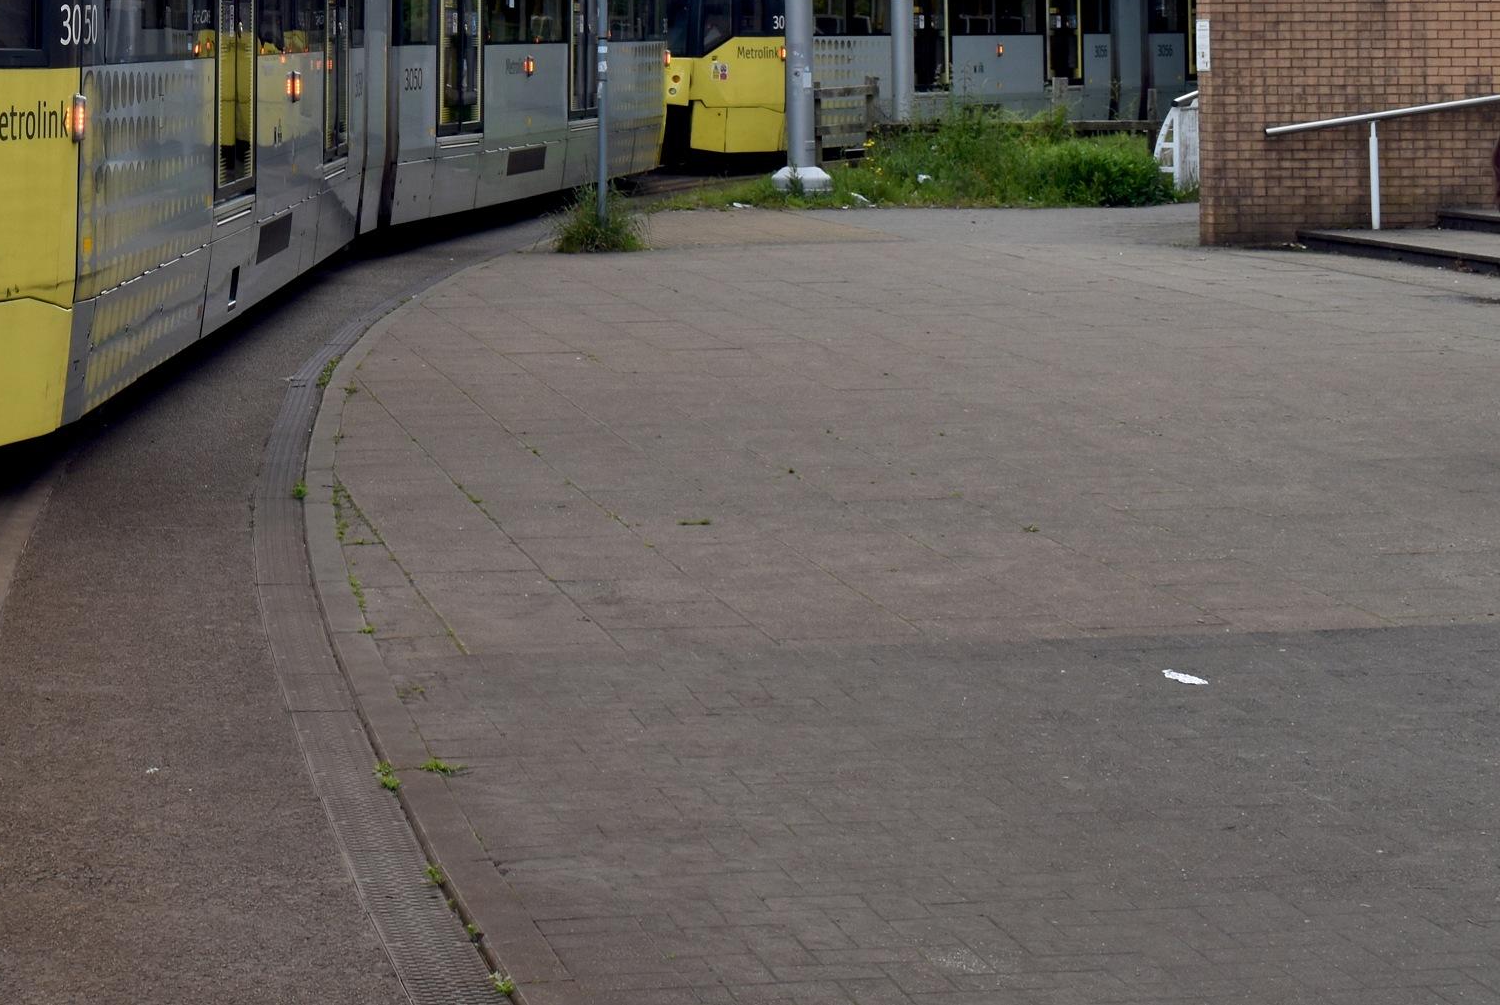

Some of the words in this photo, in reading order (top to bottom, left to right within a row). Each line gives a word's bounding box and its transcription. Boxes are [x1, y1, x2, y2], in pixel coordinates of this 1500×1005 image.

[59, 3, 98, 46] 3050
[737, 46, 779, 59] Metrolink
[404, 67, 423, 92] 3050
